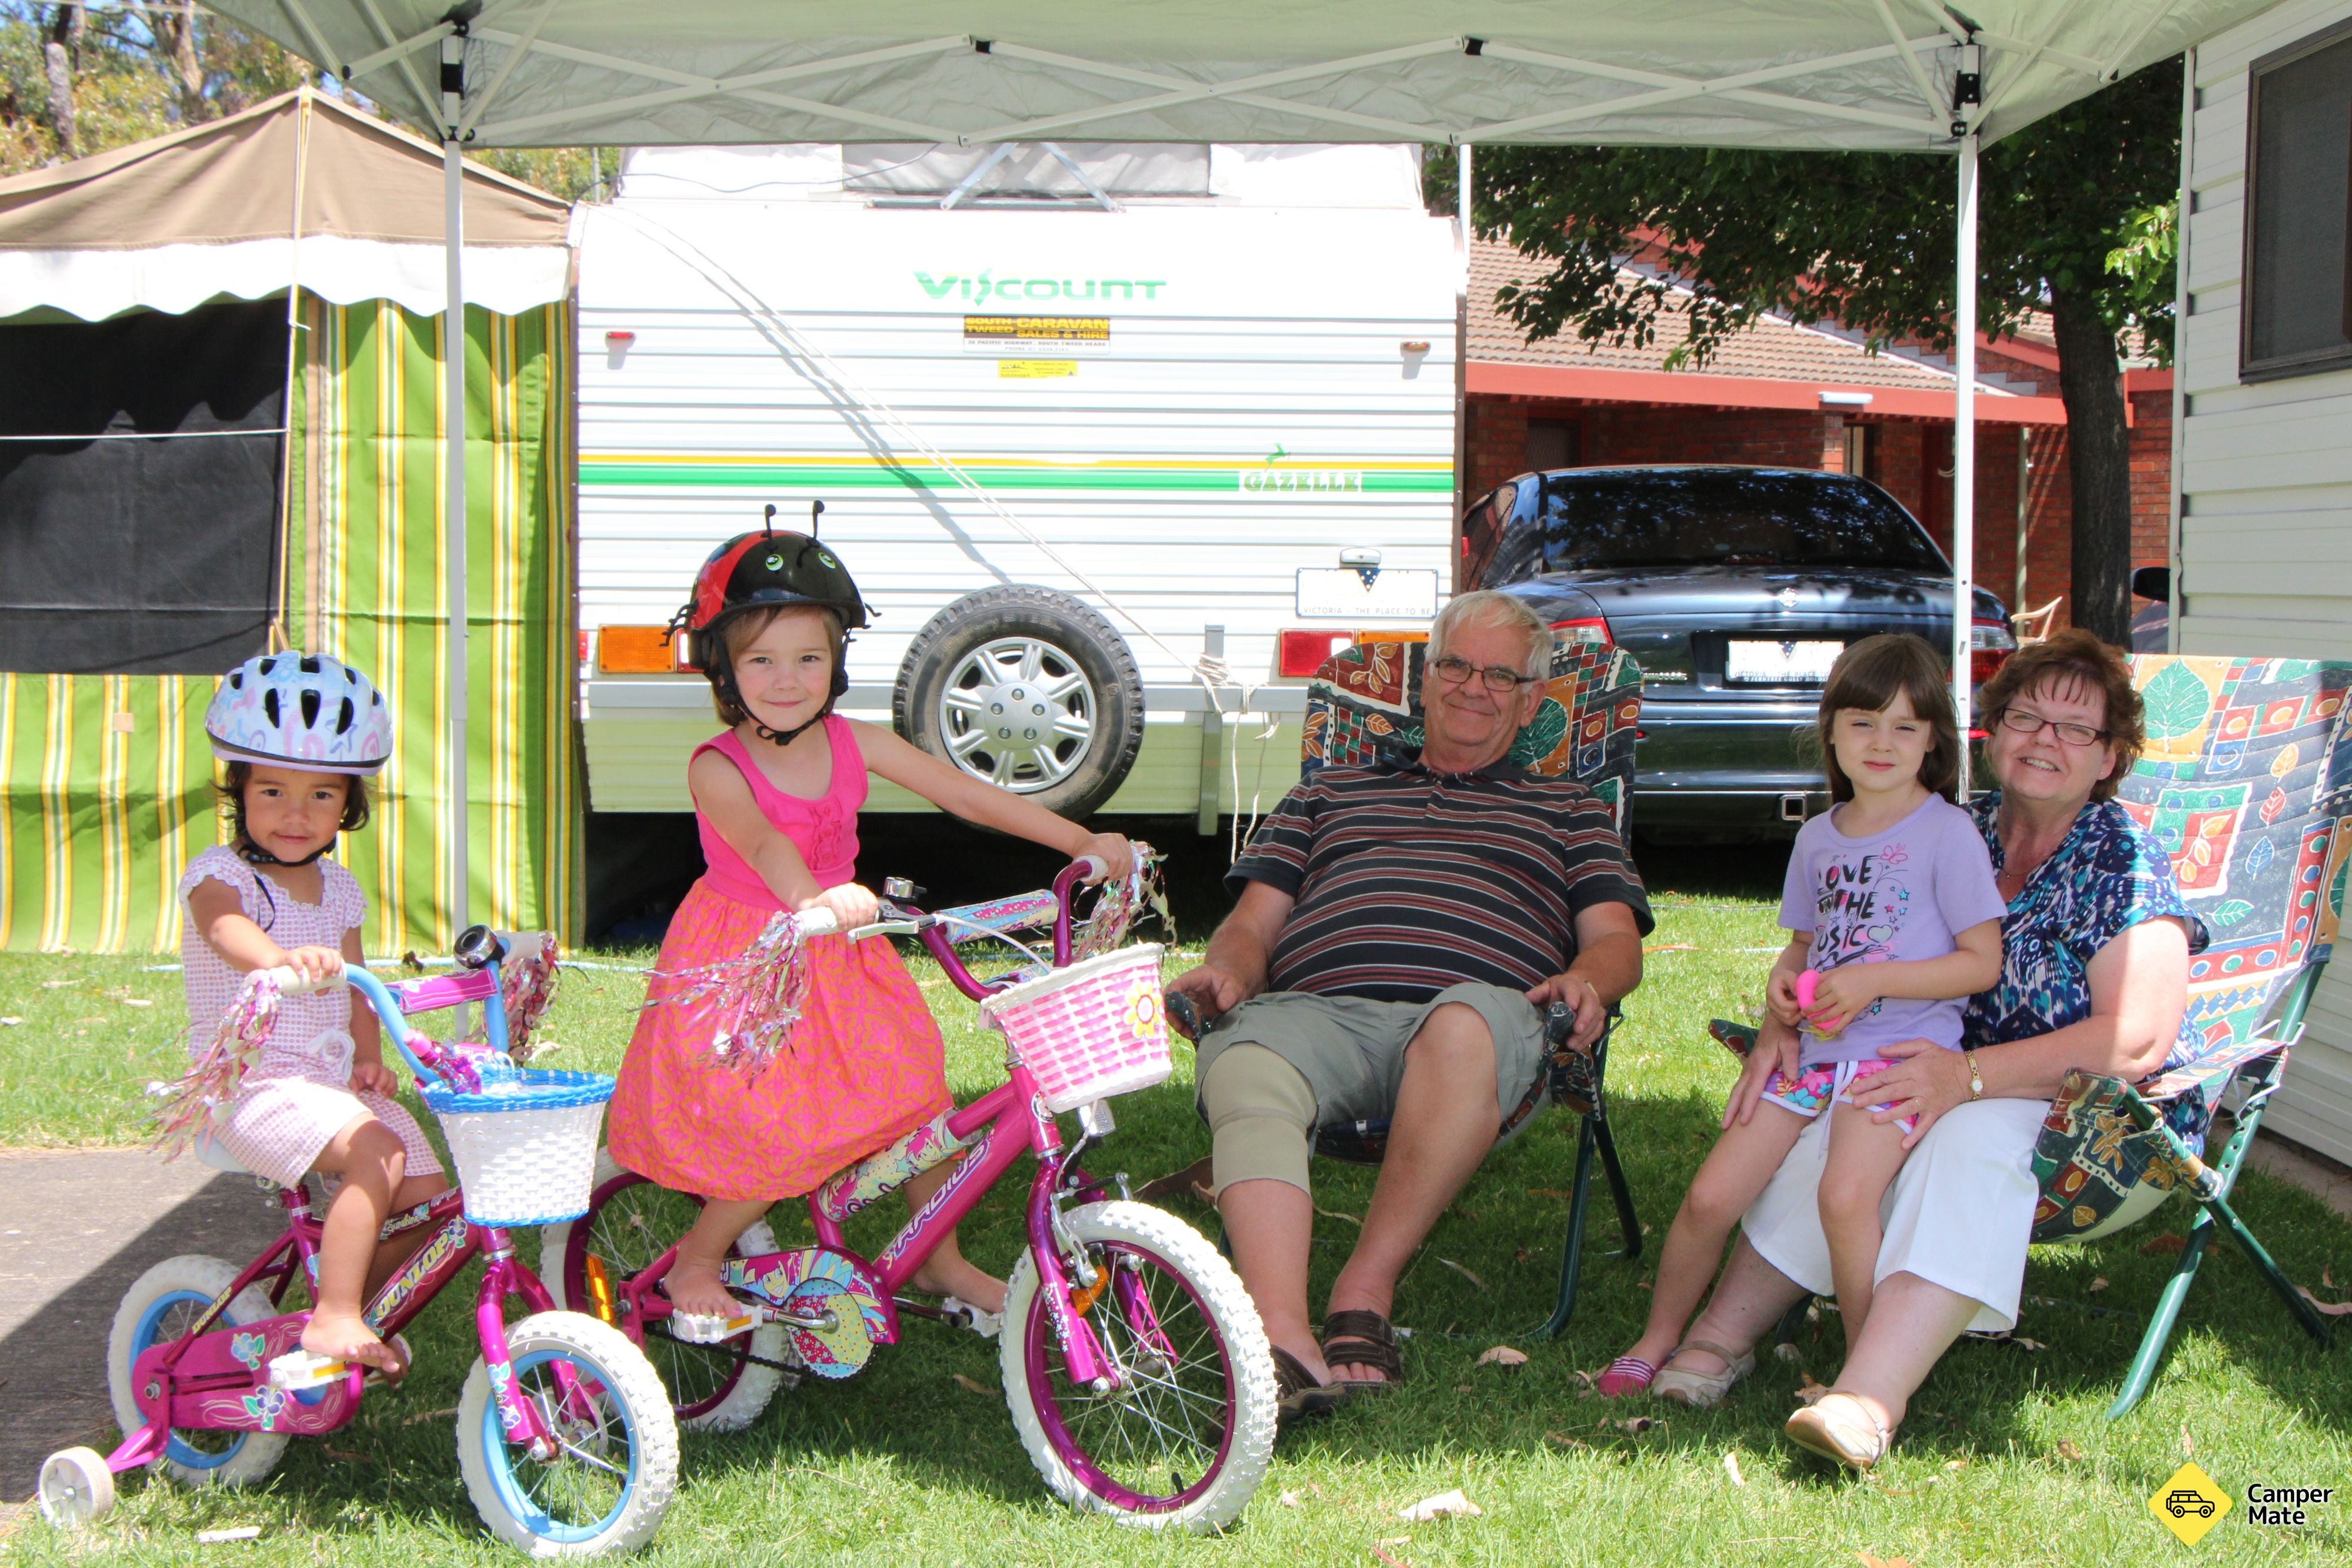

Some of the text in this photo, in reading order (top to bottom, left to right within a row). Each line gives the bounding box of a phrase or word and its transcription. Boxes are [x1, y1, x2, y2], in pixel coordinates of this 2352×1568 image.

[1016, 318, 1108, 328] CARAVAN
[1244, 471, 1360, 492] GAZELLE
[1818, 855, 1879, 889] OVE
[1832, 889, 1878, 921] THE
[1816, 924, 1866, 953] USIC
[897, 1144, 985, 1248] RADIUS
[376, 1231, 450, 1320] DUNLOP
[192, 1286, 232, 1334] DUNLOP
